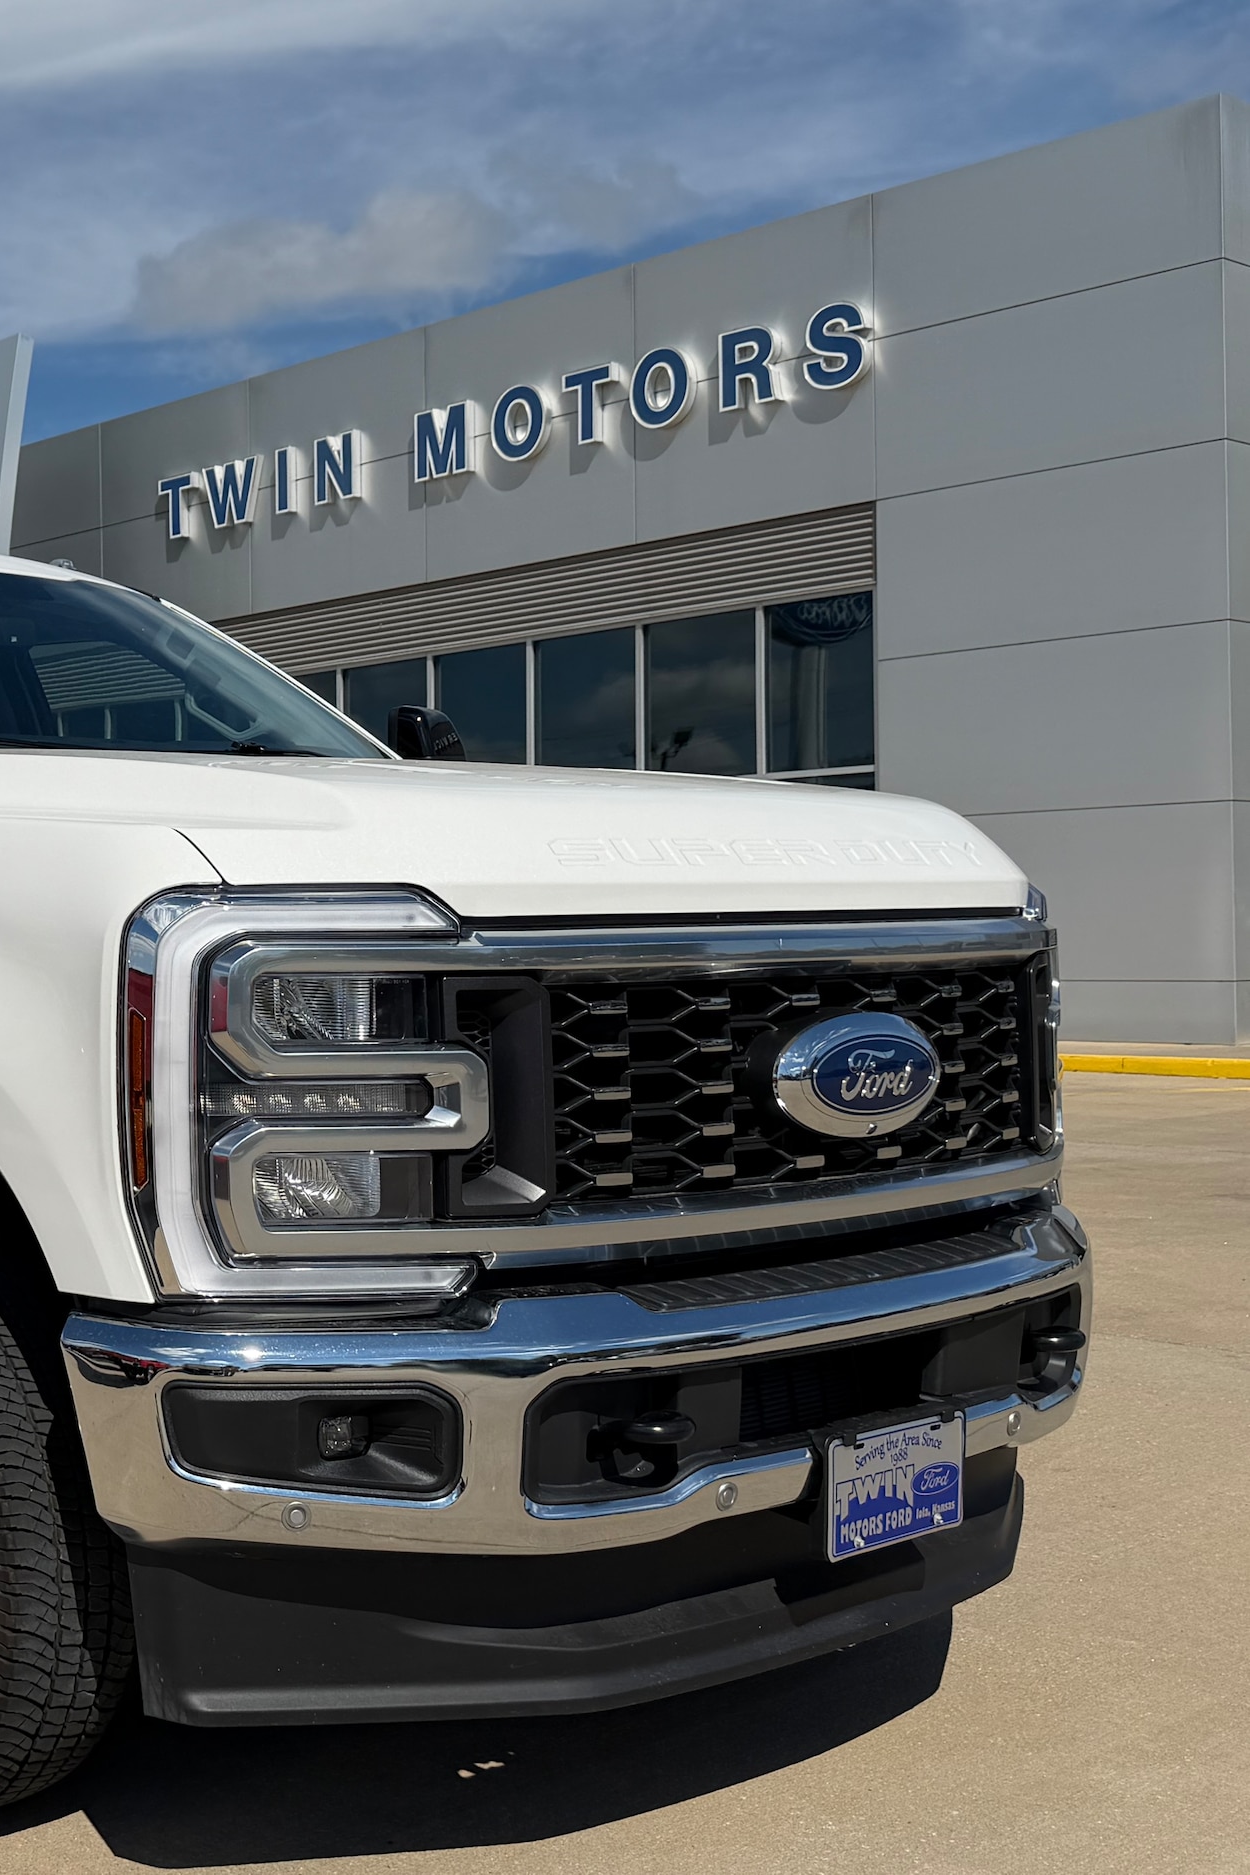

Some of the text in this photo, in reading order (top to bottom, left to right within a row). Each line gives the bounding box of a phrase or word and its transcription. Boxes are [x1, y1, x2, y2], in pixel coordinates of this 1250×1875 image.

[157, 301, 873, 540] TWIN MOTORS
[547, 837, 984, 867] SUPER DUTY
[841, 1049, 914, 1101] Ford
[854, 1431, 943, 1470] Serving the Area Since
[890, 1447, 909, 1466] 1988
[835, 1464, 914, 1521] TWIN
[920, 1467, 950, 1491] Ford
[840, 1506, 913, 1544] MOTORS FORD
[932, 1501, 955, 1515] Kansas
